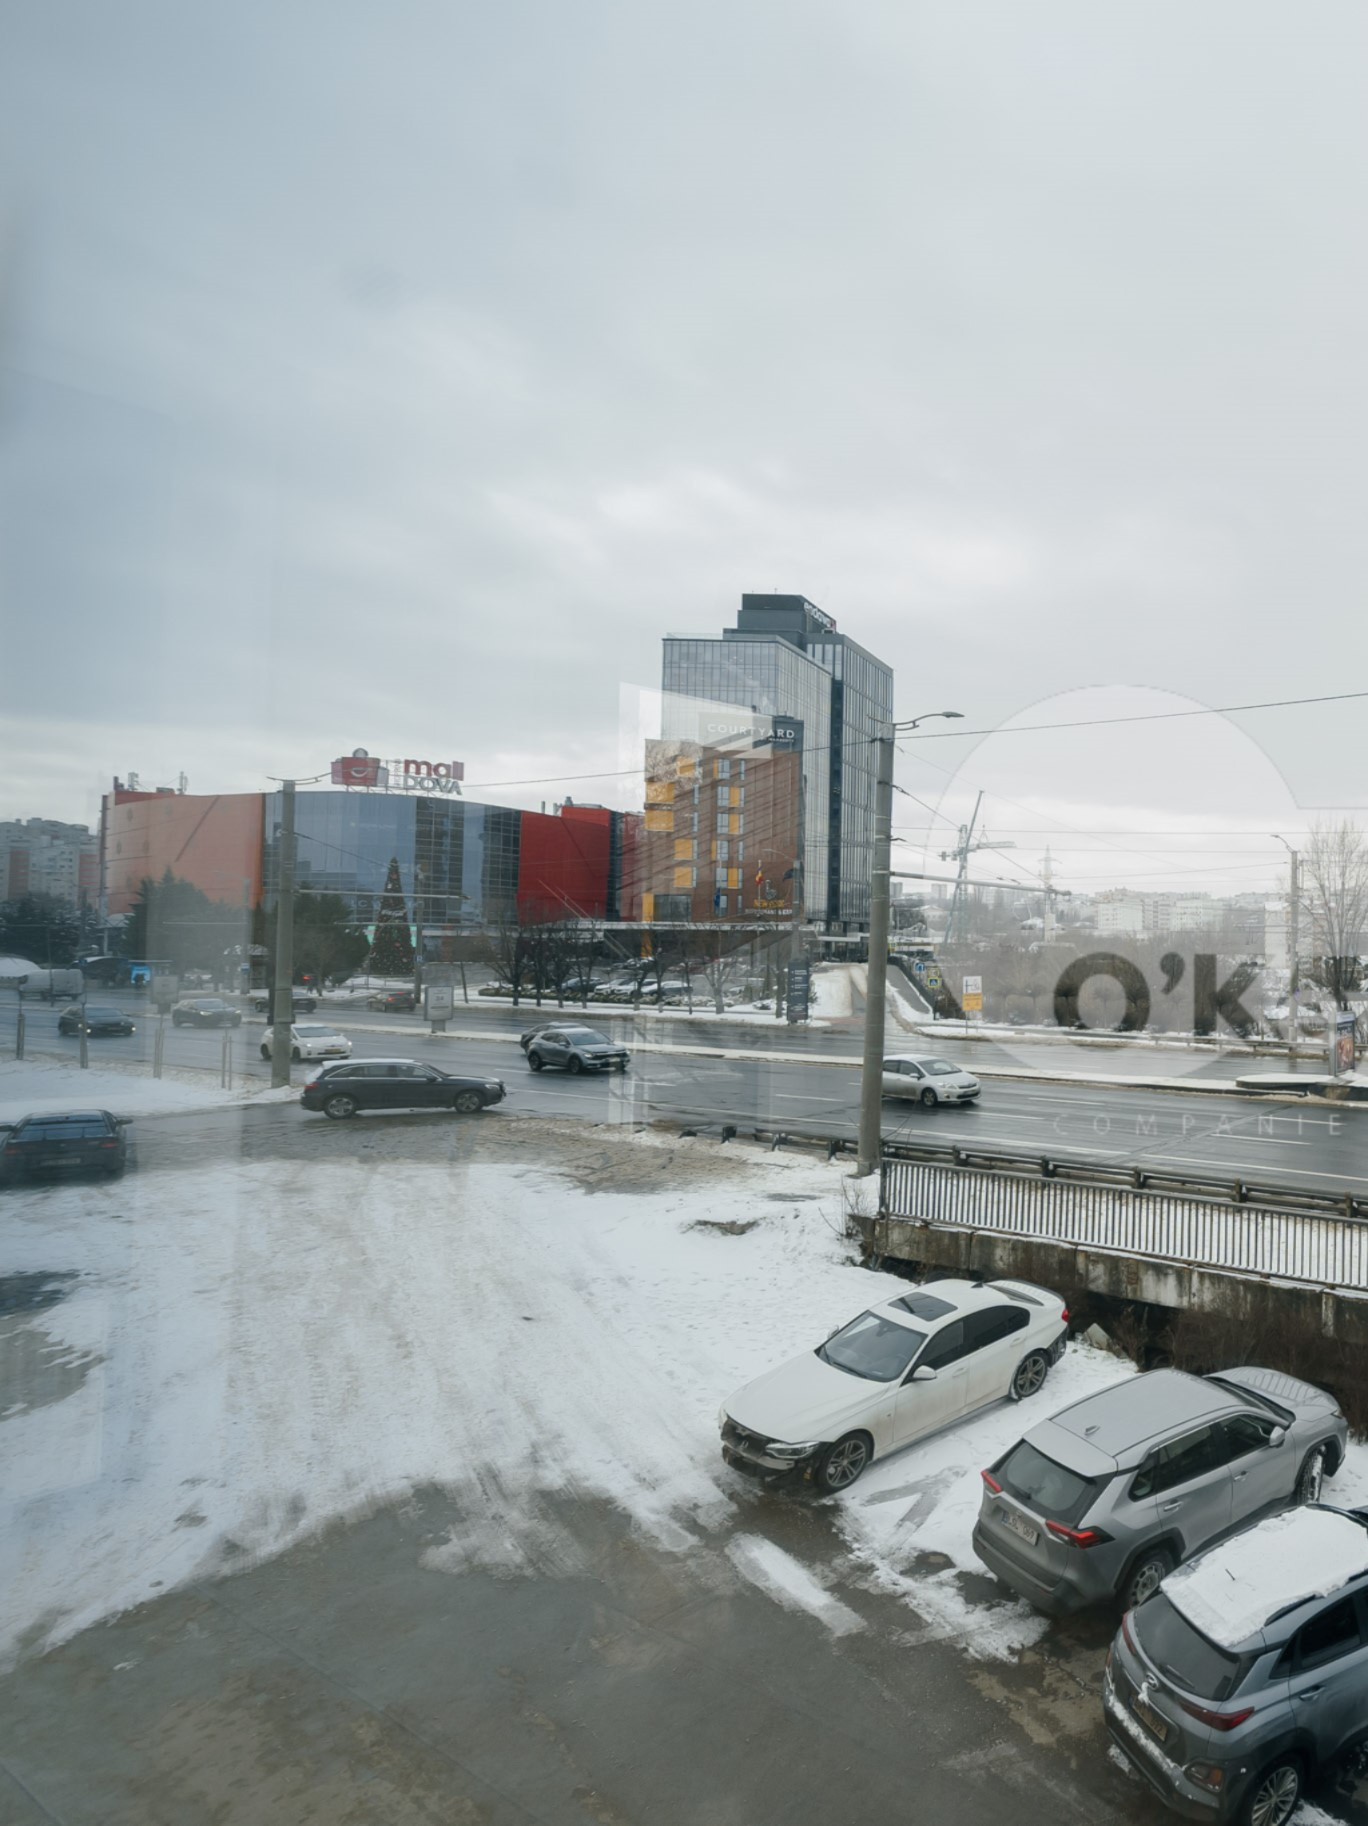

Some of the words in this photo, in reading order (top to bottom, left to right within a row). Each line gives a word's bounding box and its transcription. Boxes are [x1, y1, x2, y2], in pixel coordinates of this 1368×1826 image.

[707, 723, 795, 738] COURTYARD
[404, 759, 464, 781] mall
[404, 774, 462, 795] DOVA
